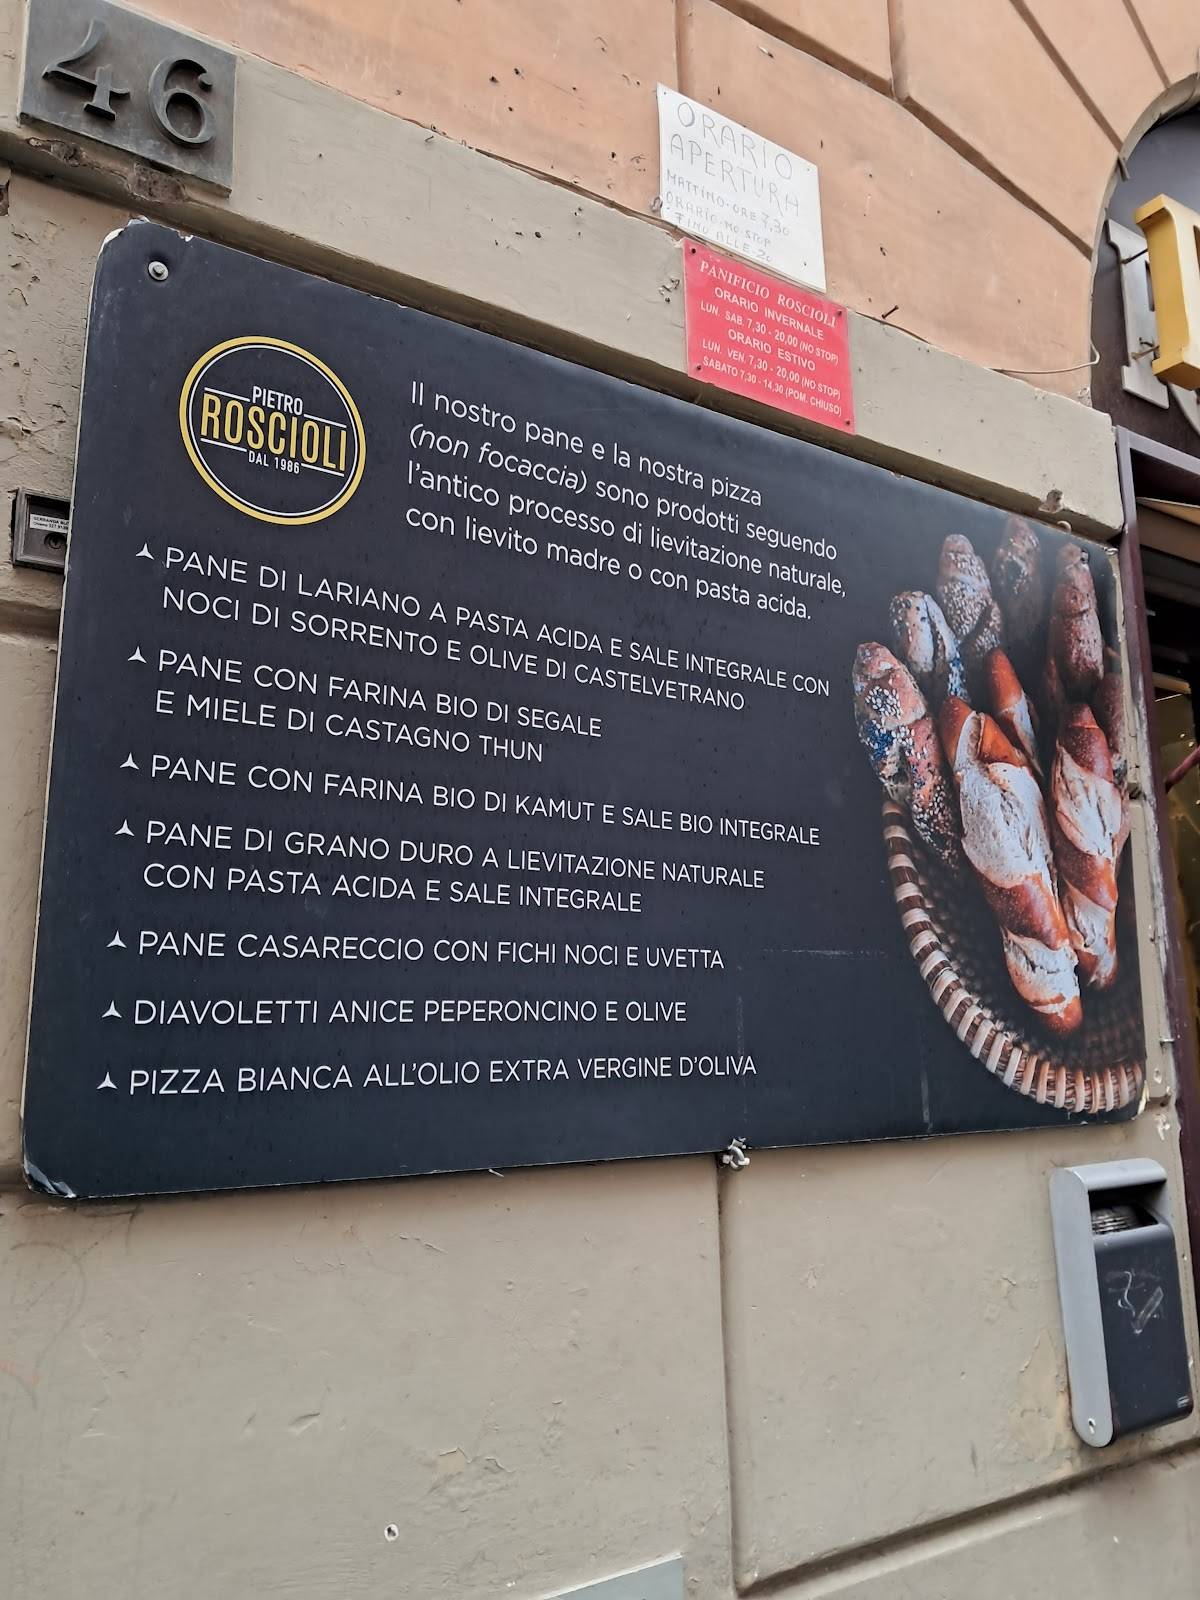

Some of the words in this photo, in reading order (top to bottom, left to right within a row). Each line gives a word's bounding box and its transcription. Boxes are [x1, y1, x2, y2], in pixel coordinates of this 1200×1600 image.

[42, 18, 217, 145] 46
[670, 133, 799, 217] APERTURA
[677, 102, 793, 180] ORARIO
[700, 260, 770, 300] PANIFICIO
[777, 293, 836, 329] ROSCIOLI
[714, 287, 759, 313] ORARIO
[764, 307, 825, 341] INVERNALE
[701, 301, 720, 316] LUN.
[725, 310, 745, 326] SAB.
[747, 317, 767, 335] 7,30
[774, 328, 798, 348] 20,00
[799, 341, 815, 356] (NO
[815, 347, 839, 366] STOP)
[728, 328, 772, 354] ORARIO
[777, 347, 816, 372] ESTIVO
[253, 385, 303, 416] PIETRO
[702, 339, 722, 354] LUN.
[727, 348, 745, 363] VEN.
[749, 355, 768, 372] 7,30
[776, 365, 800, 384] 20,00
[801, 376, 816, 391] (NO
[817, 382, 841, 400] STOP)
[703, 355, 738, 377] SABATO
[739, 369, 757, 384] 7,30
[764, 379, 784, 394] 14,30
[785, 386, 808, 404] (POM.
[810, 395, 842, 417] CHIUSO)
[200, 393, 347, 471] ROSCIOLI
[248, 451, 269, 467] DAL
[274, 457, 300, 474] 1986
[412, 381, 423, 405] Il
[435, 394, 516, 432] nostro
[526, 422, 583, 453] pane
[592, 443, 604, 460] e
[614, 446, 630, 468] la
[640, 456, 703, 489] nostra
[712, 482, 761, 506] pizza
[410, 424, 468, 458] (non
[479, 442, 587, 494] focaccia)
[596, 481, 648, 509] sono
[657, 498, 738, 534] prodotti
[746, 523, 837, 560] seguendo
[406, 508, 454, 535] con
[466, 516, 537, 555] lievito
[548, 543, 620, 575] madre
[629, 563, 642, 580] o
[650, 569, 687, 591] con
[696, 579, 749, 605] pasta
[757, 594, 812, 618] acida.
[409, 460, 499, 506] l'antico
[510, 494, 614, 536] processo
[623, 521, 641, 544] di
[651, 526, 762, 574] lievitazione
[769, 563, 845, 598] naturale,
[164, 587, 239, 620] NOCI
[253, 603, 278, 627] DI
[291, 611, 437, 655] SORRENTO
[448, 640, 461, 660] E
[470, 645, 537, 674] OLIVE
[547, 659, 565, 679] DI
[575, 664, 744, 710] CASTELVETRANO
[166, 547, 247, 583] PANE
[260, 566, 285, 591] DI
[299, 574, 420, 616] LARIANO
[429, 602, 446, 623] A
[457, 607, 528, 639] PASTA
[537, 624, 602, 653] ACIDA
[611, 638, 622, 657] E
[630, 642, 678, 668] SALE
[686, 653, 787, 688] INTEGRALE
[793, 675, 829, 696] CON
[157, 690, 174, 714] E
[188, 695, 276, 727] MIELE
[288, 708, 313, 732] DI
[326, 714, 469, 752] CASTAGNO
[479, 735, 542, 762] THUN
[159, 650, 242, 683] PANE
[254, 665, 316, 694] CON
[329, 677, 426, 711] FARINA
[437, 694, 477, 718] BIO
[487, 702, 508, 723] DI
[518, 707, 601, 737] SEGALE
[152, 755, 236, 785] PANE
[249, 766, 312, 792] CON
[325, 774, 423, 804] FARINA
[434, 786, 475, 809] BIO
[485, 791, 505, 812] DI
[516, 795, 594, 821] KAMUT
[603, 805, 614, 823] E
[623, 807, 672, 829] SALE
[681, 813, 712, 833] BIO
[720, 818, 819, 845] INTEGRALE
[144, 863, 214, 889] CON
[228, 868, 321, 895] PASTA
[332, 875, 415, 899] ACIDA
[426, 880, 440, 901] E
[450, 881, 510, 904] SALE
[520, 886, 641, 912] INTEGRALE
[147, 821, 232, 849] PANE
[245, 828, 272, 851] DI
[285, 832, 389, 859] GRANO
[400, 841, 473, 865] DURO
[482, 848, 498, 868] A
[509, 849, 655, 879] LIEVITAZIONE
[663, 862, 764, 888] NATURALE
[140, 931, 225, 956] PANE
[238, 934, 423, 960] CASARECCIO
[434, 940, 487, 961] CON
[498, 942, 555, 963] FICHI
[565, 944, 617, 965] NOCI
[627, 947, 638, 966] E
[647, 947, 724, 968] UVETTA
[135, 1000, 317, 1024] DIAVOLETTI
[329, 1000, 414, 1023] ANICE
[425, 1000, 597, 1021] PEPERONCINO
[606, 1001, 617, 1021] E
[626, 1001, 686, 1021] OLIVE
[130, 1069, 224, 1095] PIZZA
[238, 1065, 352, 1091] BIANCA
[363, 1061, 479, 1087] ALL'OLIO
[490, 1059, 569, 1082] EXTRA
[577, 1057, 672, 1079] VERGINE
[680, 1056, 756, 1076] D'OLIVA
